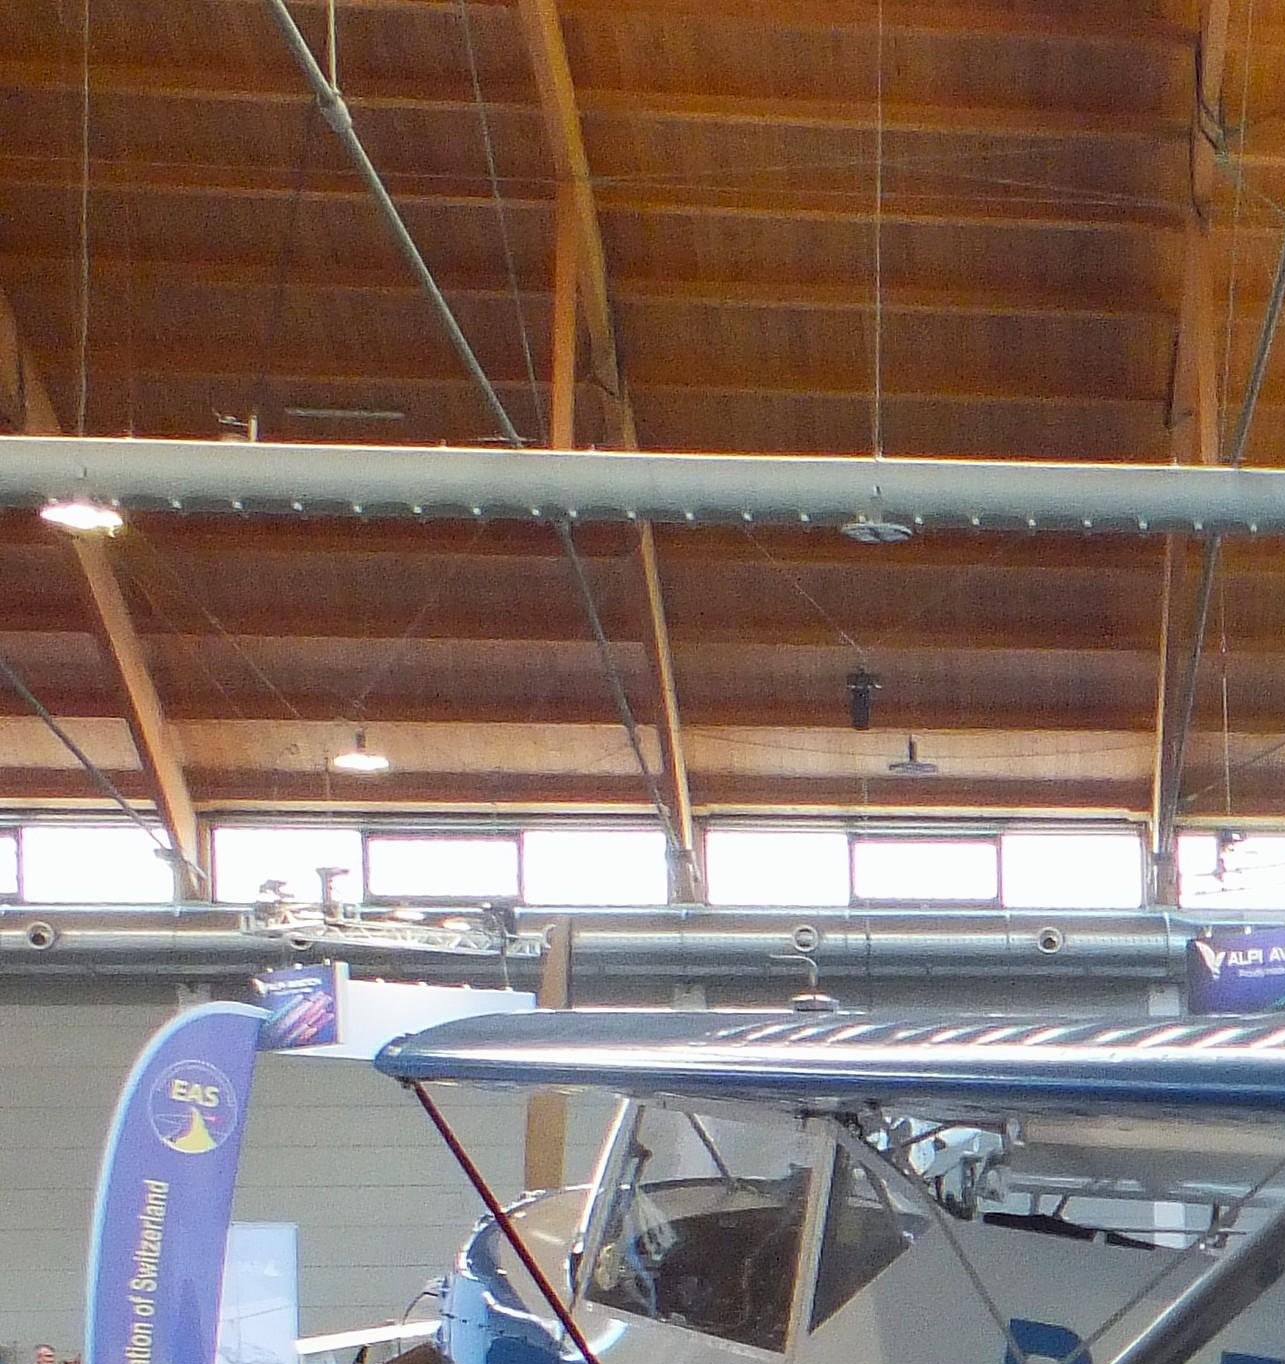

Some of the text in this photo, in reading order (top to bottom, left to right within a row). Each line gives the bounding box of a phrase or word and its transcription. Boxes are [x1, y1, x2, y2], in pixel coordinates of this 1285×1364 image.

[1228, 949, 1263, 966] ALPI
[170, 1079, 220, 1107] EAS
[130, 1179, 170, 1292] Switzerland
[127, 1294, 156, 1316] of
